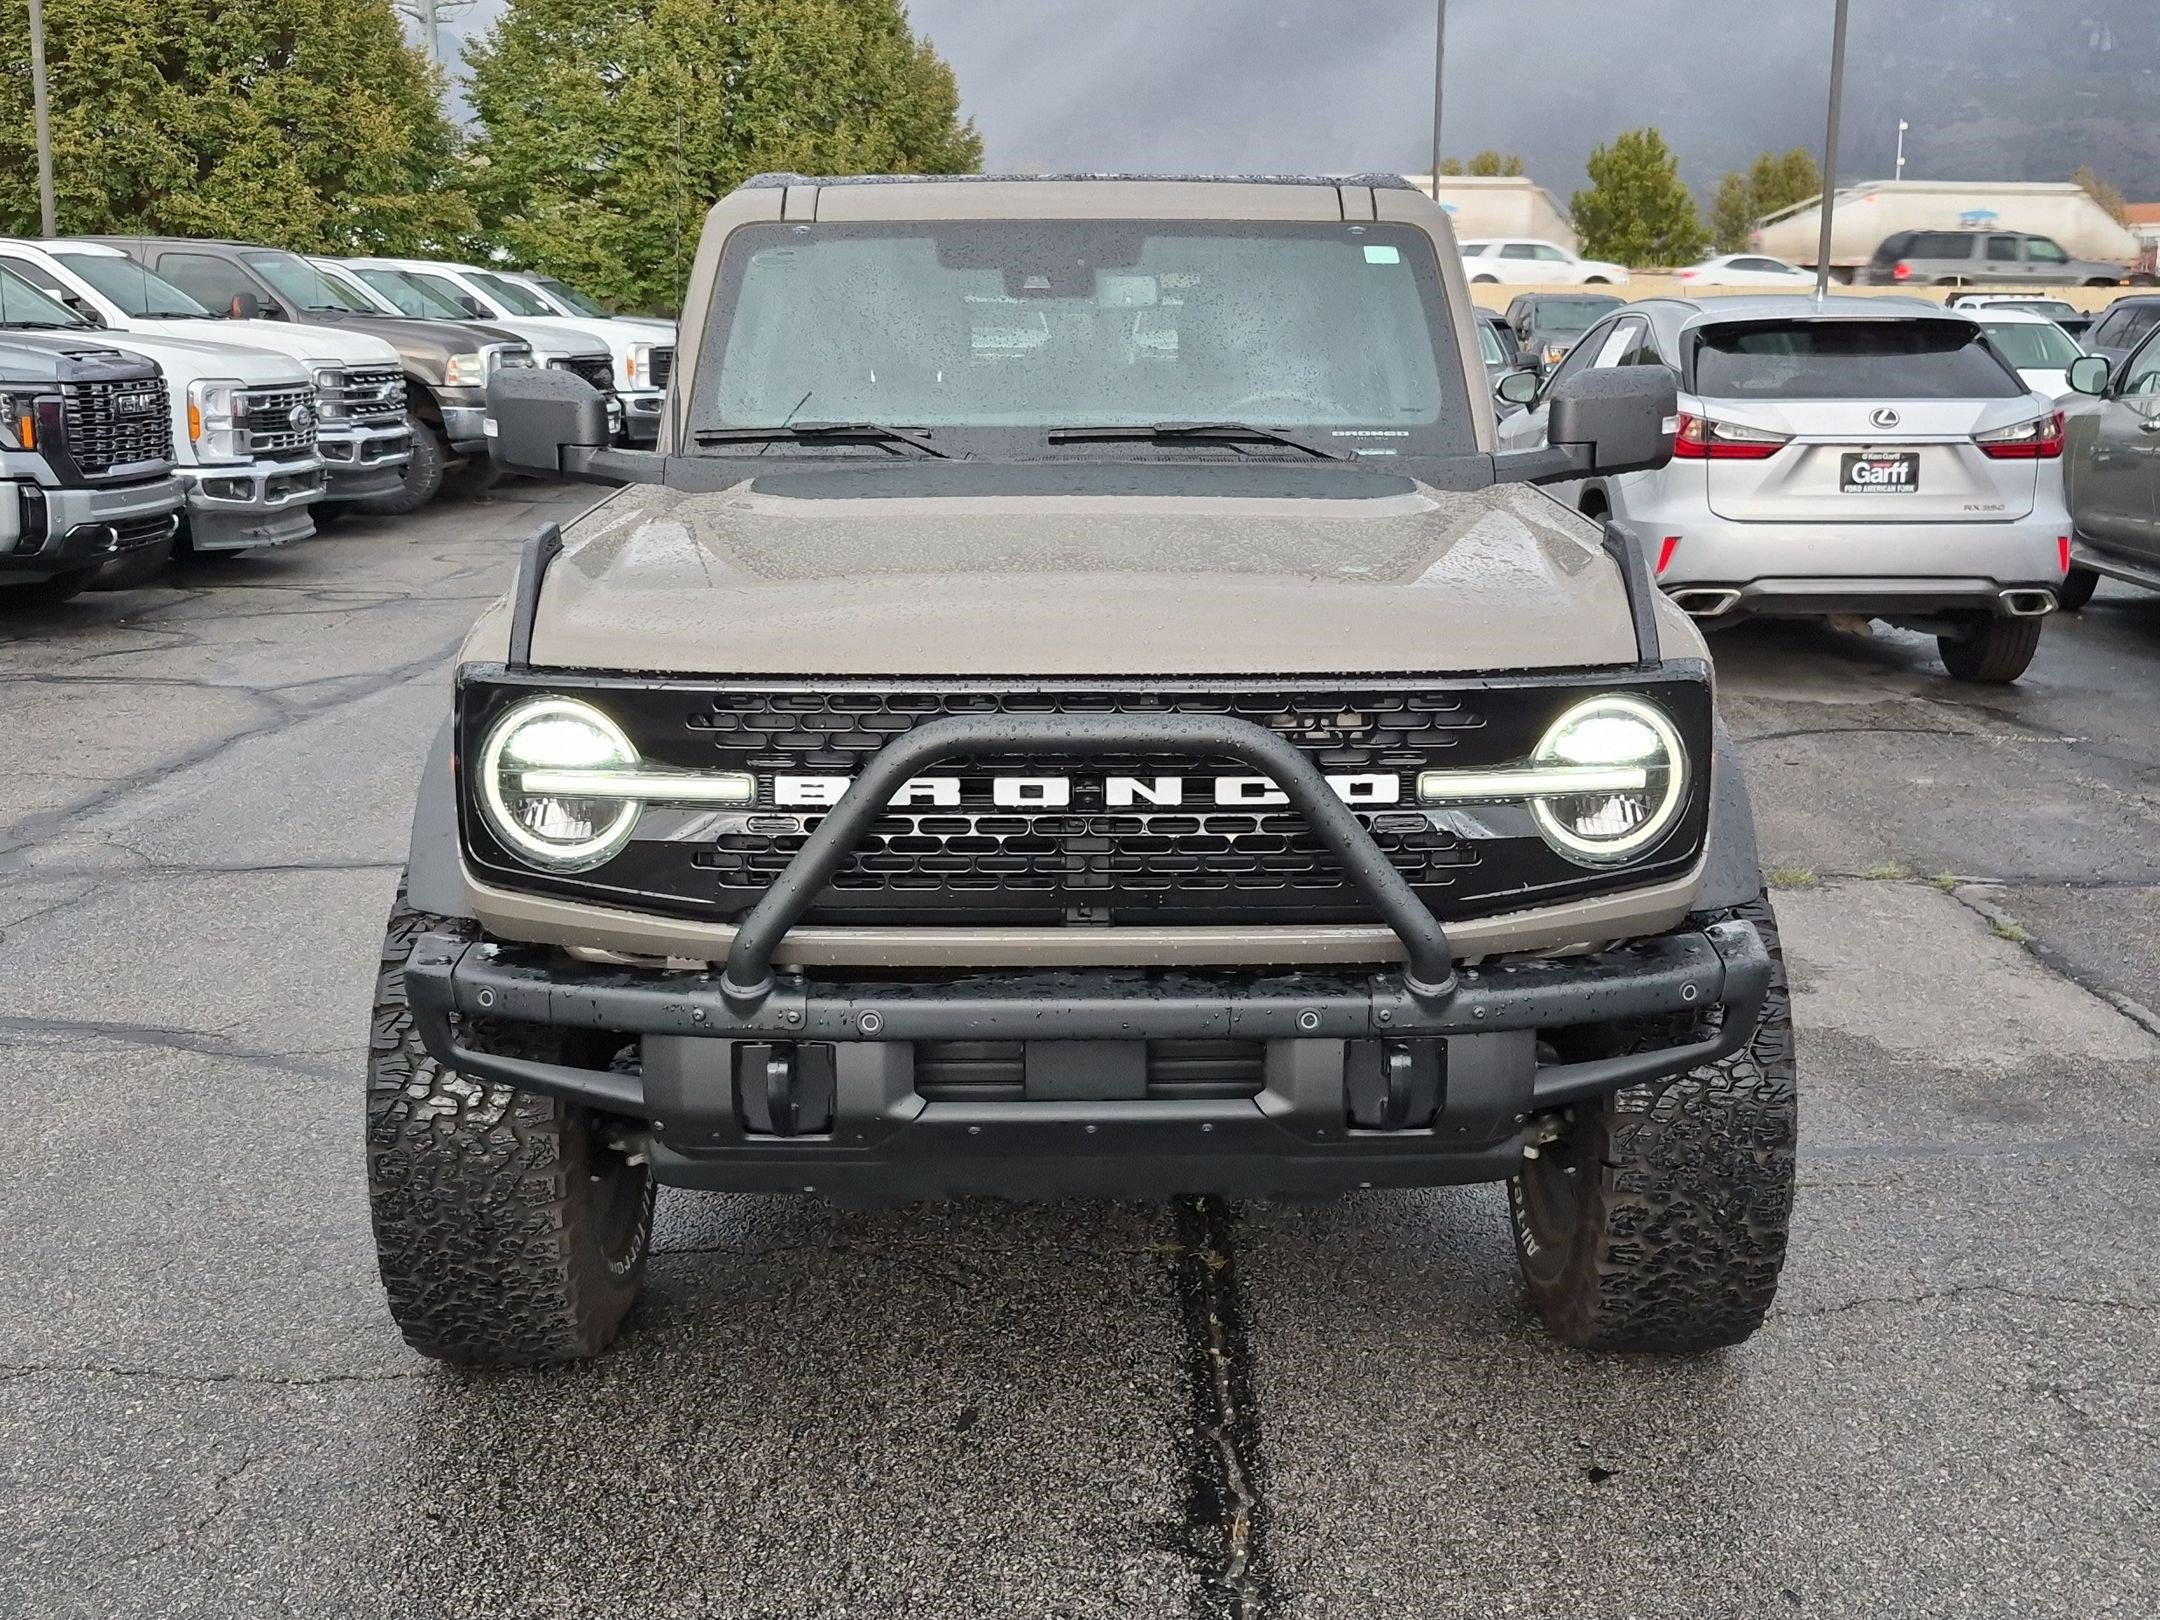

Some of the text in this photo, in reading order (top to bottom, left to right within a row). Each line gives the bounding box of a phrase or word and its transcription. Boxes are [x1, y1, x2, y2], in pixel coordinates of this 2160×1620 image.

[119, 394, 158, 413] GMC
[1852, 461, 1908, 483] Garff
[774, 775, 1400, 807] BRONCO
